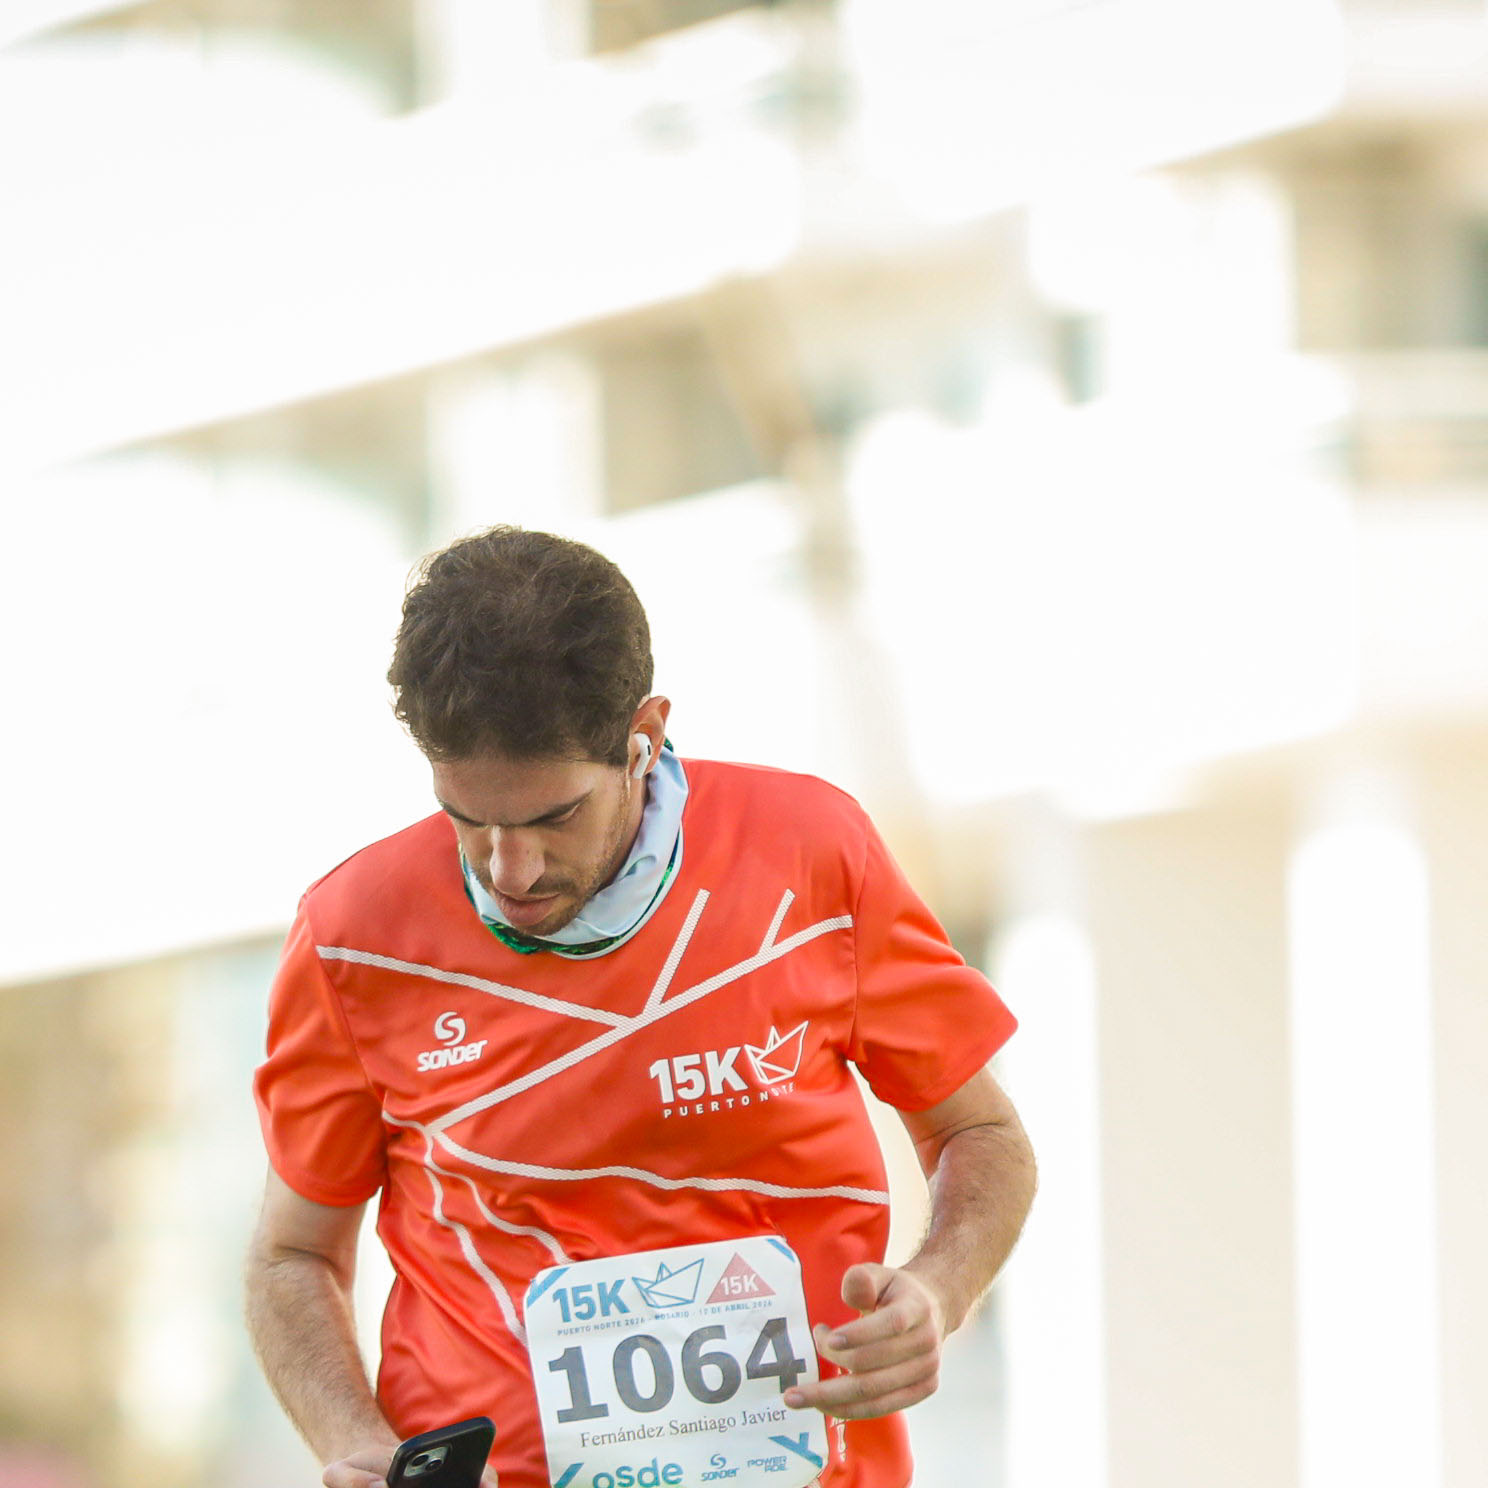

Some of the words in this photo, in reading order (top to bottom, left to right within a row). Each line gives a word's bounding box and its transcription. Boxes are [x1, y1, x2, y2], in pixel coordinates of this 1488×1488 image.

[649, 1046, 749, 1104] 15K
[663, 1095, 750, 1119] PUERTO
[759, 1082, 795, 1102] NOTE
[553, 1279, 630, 1323] 15K
[720, 1274, 760, 1296] 15K
[557, 1325, 591, 1336] PUERTO
[594, 1320, 622, 1331] NORTE
[724, 1303, 750, 1313] ABRIL
[548, 1317, 806, 1424] 1064
[580, 1424, 665, 1448] Fernández
[669, 1414, 736, 1436] Santiago
[741, 1407, 788, 1426] Javier
